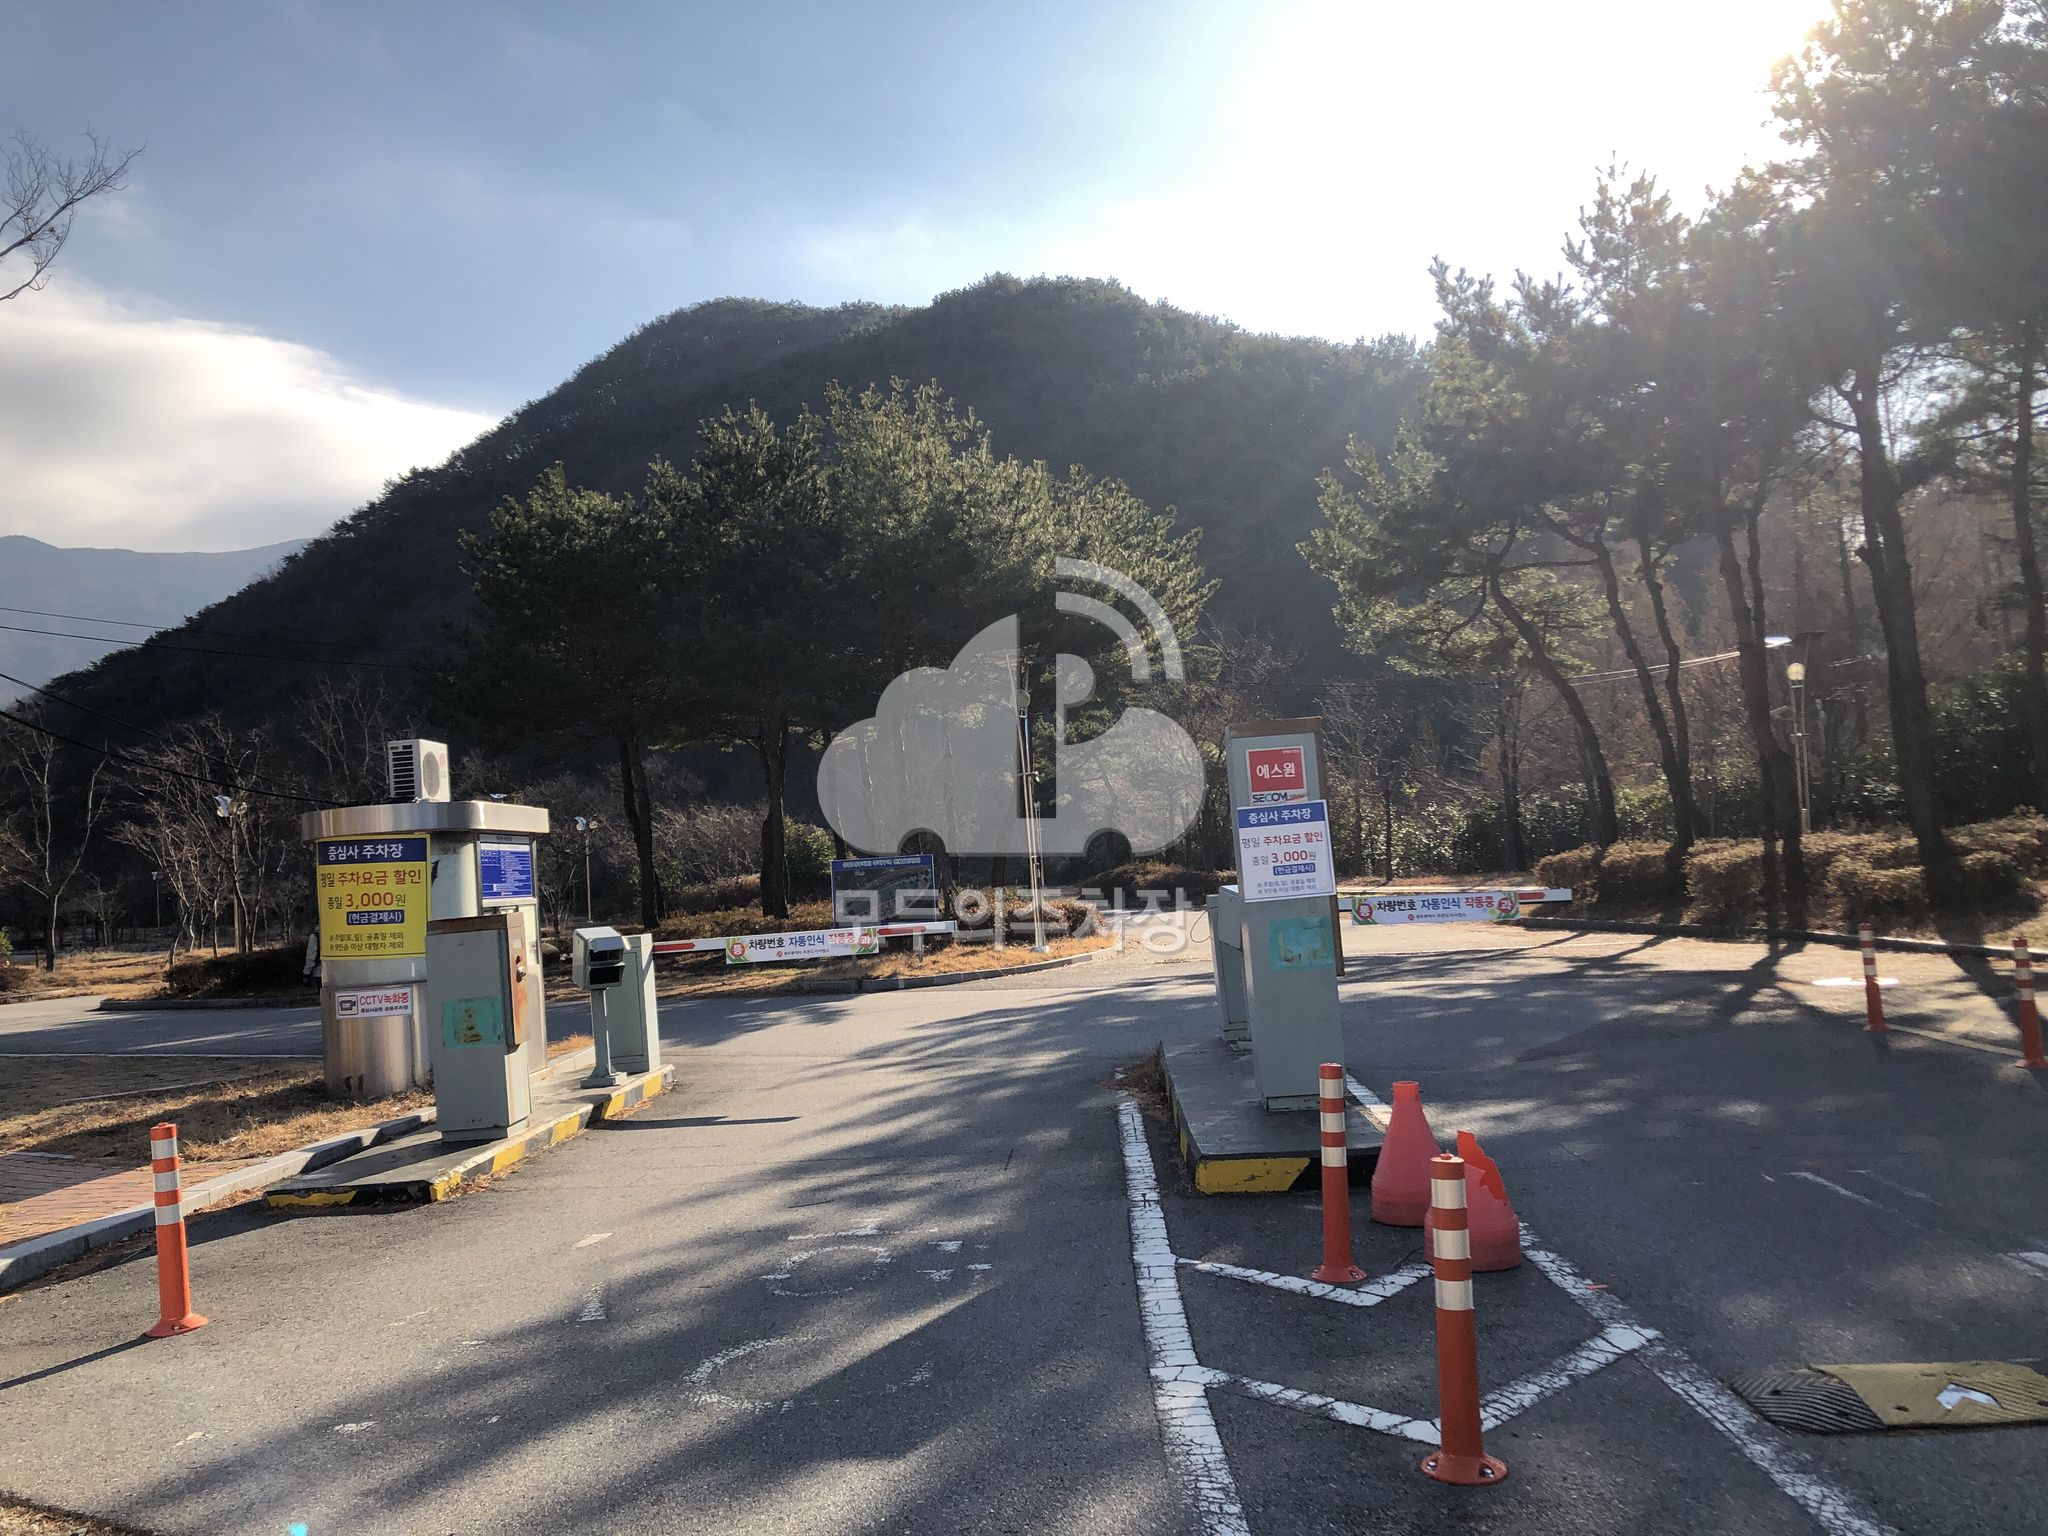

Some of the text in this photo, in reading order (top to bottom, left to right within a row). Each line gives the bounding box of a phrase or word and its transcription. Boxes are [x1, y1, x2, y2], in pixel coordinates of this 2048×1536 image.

[1256, 762, 1296, 779] 에스원
[1252, 792, 1288, 803] SECOM
[1248, 807, 1311, 824] 증심사 주차장
[1241, 831, 1324, 849] 평일 주차요금 할인
[328, 843, 403, 861] 증심사 주차장
[1251, 850, 1317, 867] 종일 3,000원
[338, 870, 389, 887] 주차요금
[393, 869, 421, 885] 할인
[327, 891, 406, 910] 종일 3,000원
[1376, 899, 1418, 912] 차량번호
[1420, 897, 1462, 910] 자동인식
[1464, 896, 1495, 909] 작동중
[348, 912, 402, 924] (현금결제시)
[748, 937, 786, 951] 차량번호
[788, 934, 826, 947] 자동인식
[360, 992, 409, 1006] CCTV녹화중
